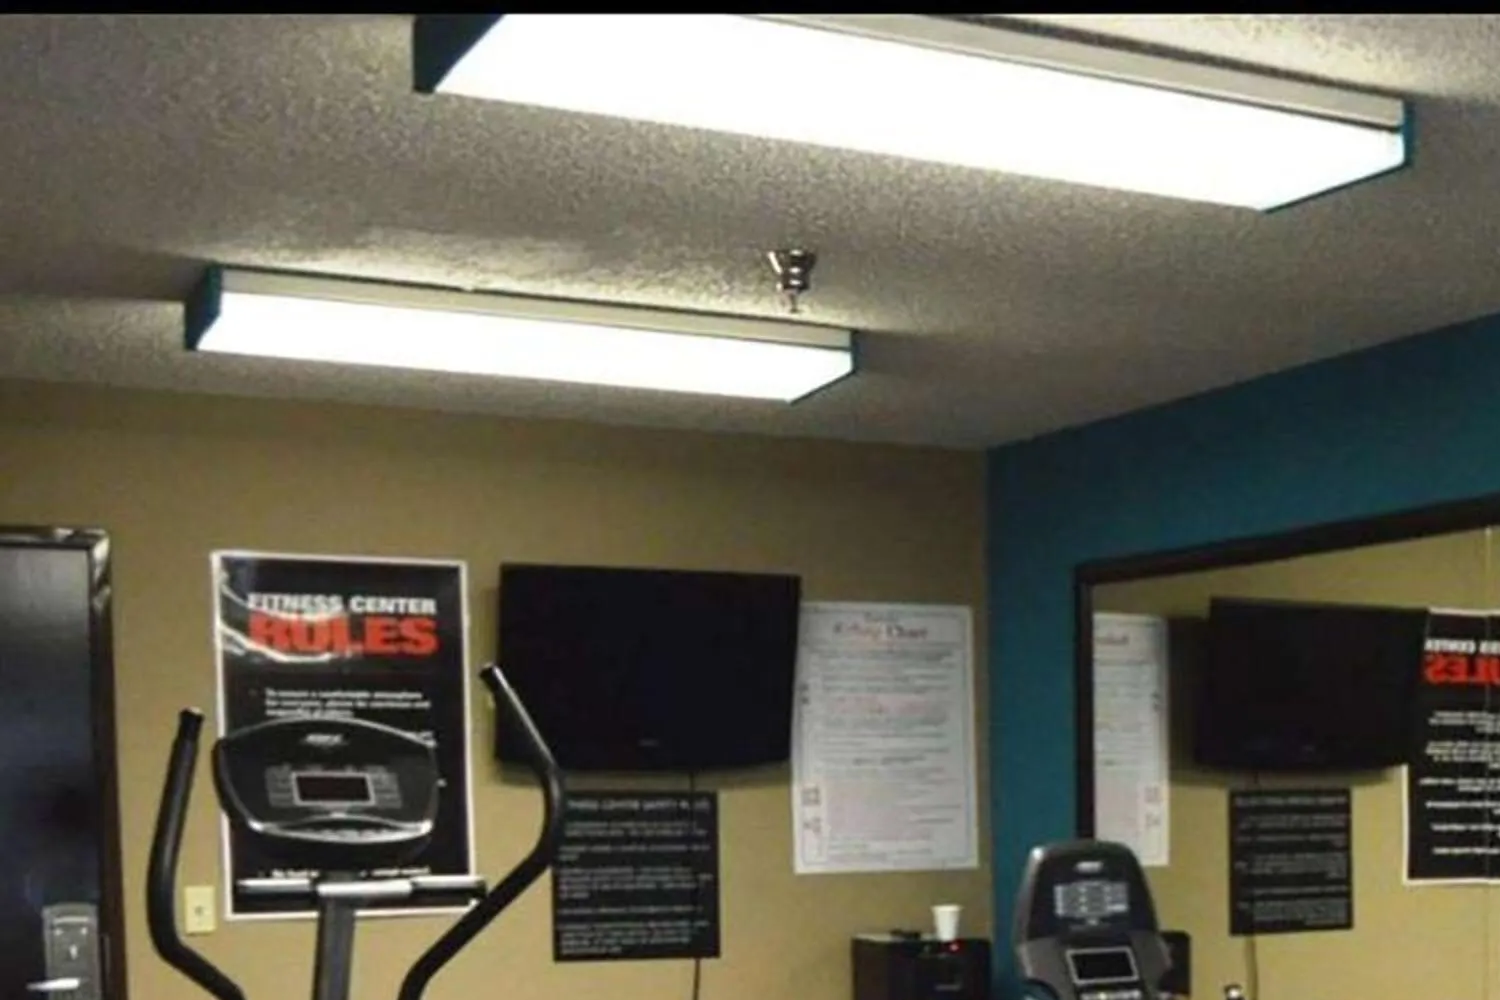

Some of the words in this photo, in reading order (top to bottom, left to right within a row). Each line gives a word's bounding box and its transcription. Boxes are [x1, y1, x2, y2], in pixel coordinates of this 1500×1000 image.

[247, 593, 343, 614] FITNESS
[350, 595, 437, 615] CENTER
[249, 610, 439, 656] RULES
